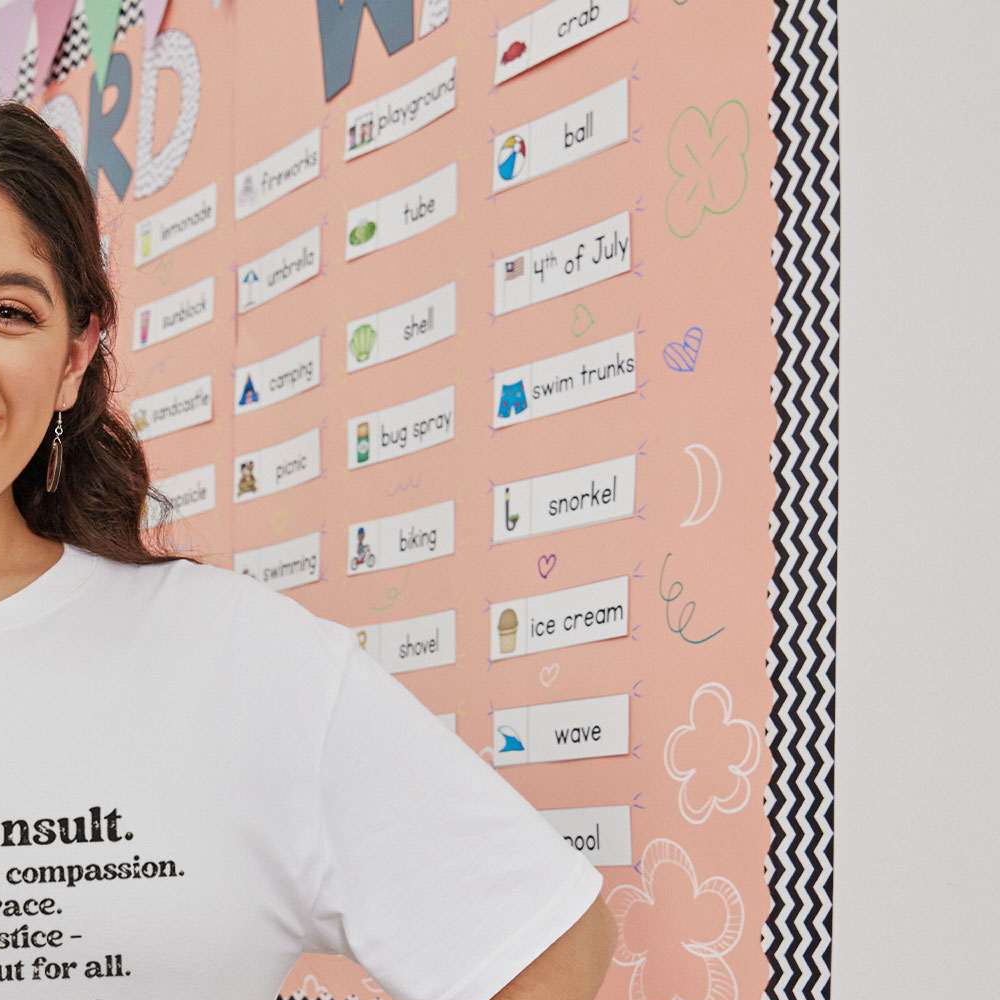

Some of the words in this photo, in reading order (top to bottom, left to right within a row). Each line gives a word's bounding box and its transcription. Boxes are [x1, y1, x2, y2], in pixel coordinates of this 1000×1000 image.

[557, 0, 601, 38] crab
[377, 66, 457, 136] playground
[564, 110, 594, 149] ball
[261, 147, 318, 195] fireworks
[160, 202, 213, 241] lemonade
[404, 195, 436, 225] tube
[267, 246, 315, 287] umbrella
[533, 252, 558, 284] 4th
[564, 243, 584, 275] of
[592, 230, 629, 264] July
[162, 291, 208, 330] sunblock
[404, 306, 434, 341] shell
[269, 360, 313, 391] camping
[531, 374, 574, 400] swim
[580, 351, 635, 387] trunks
[152, 387, 210, 422] sandcastle
[381, 424, 408, 449] bug
[412, 411, 451, 441] spray
[275, 455, 307, 485] picnic
[548, 475, 618, 517] snorkel
[399, 525, 437, 552] biking
[262, 554, 317, 583] swimming
[530, 618, 557, 639] ice
[563, 604, 624, 632] cream
[399, 627, 439, 660] shovel
[554, 724, 602, 745] wave
[5, 854, 186, 888] compassion.
[32, 956, 78, 981] for
[84, 954, 132, 979] all.
